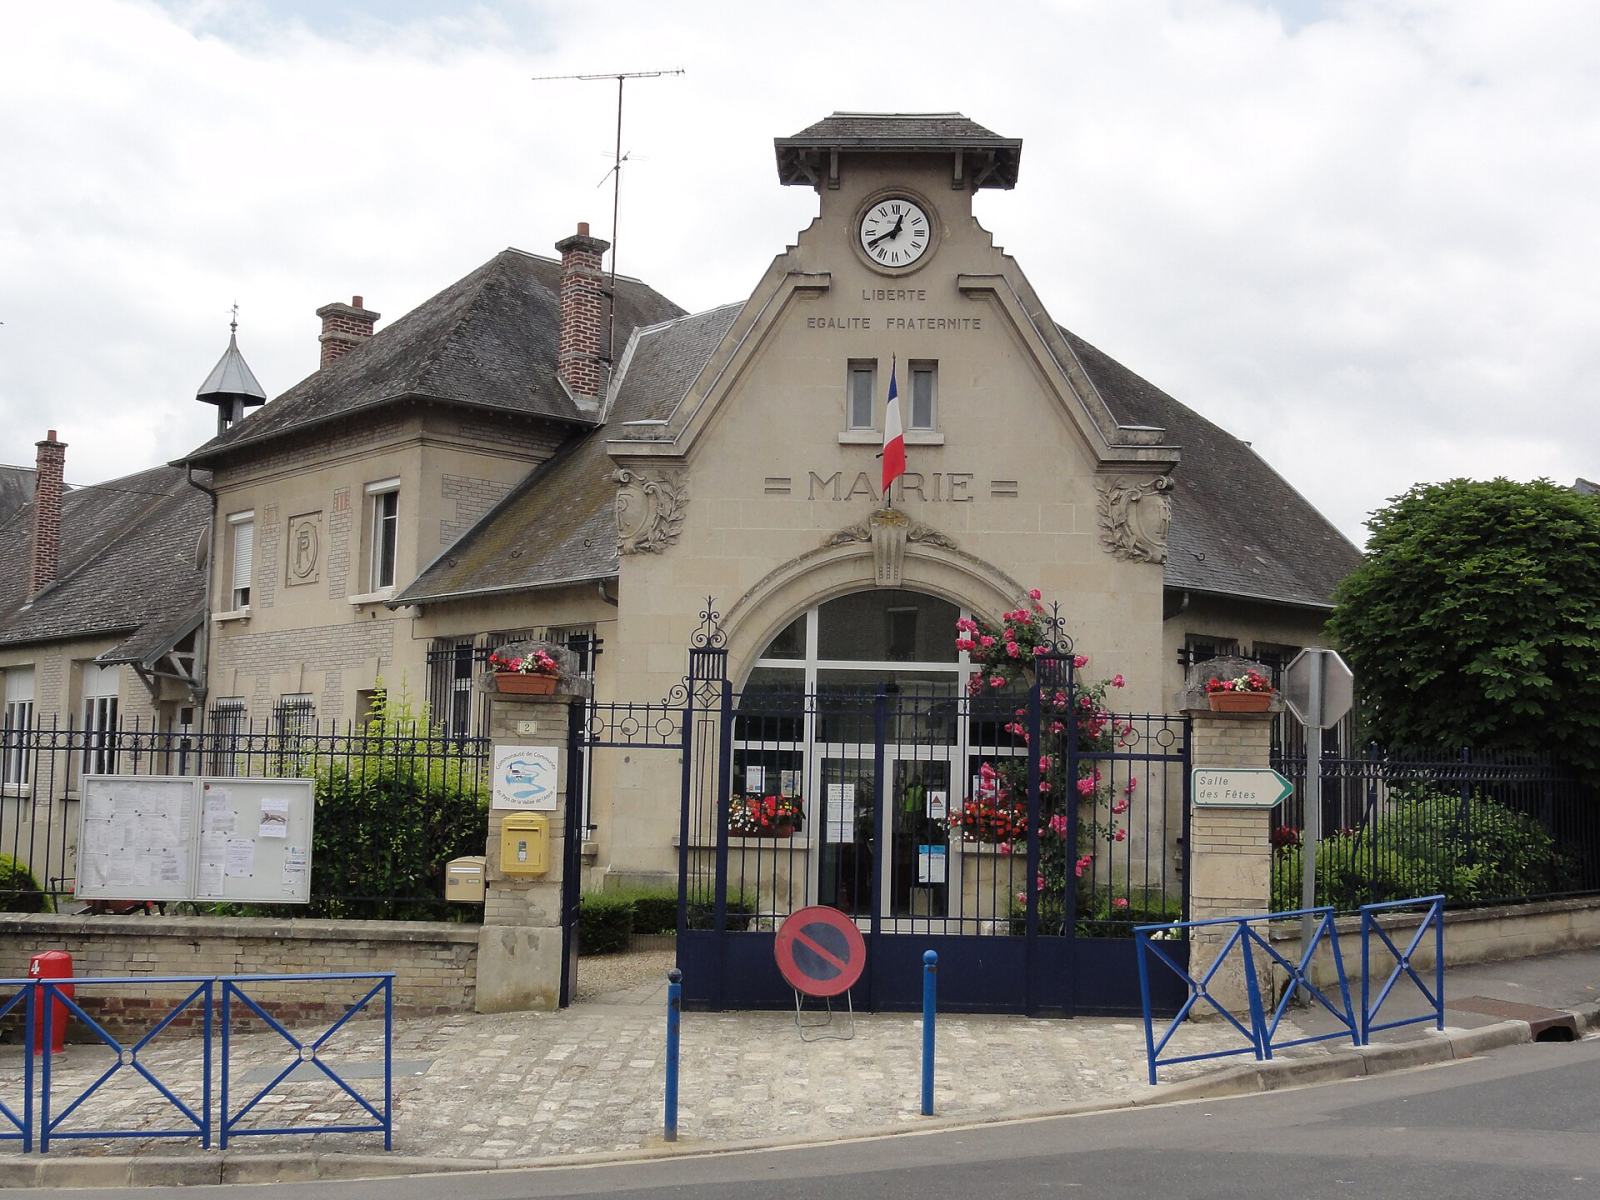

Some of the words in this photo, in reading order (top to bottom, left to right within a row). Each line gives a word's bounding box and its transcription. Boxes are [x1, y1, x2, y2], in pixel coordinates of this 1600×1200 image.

[862, 290, 927, 302] LIBERTE
[807, 317, 871, 330] EGALITE
[886, 318, 982, 331] FRATERNITE
[524, 723, 530, 732] 2
[1200, 776, 1229, 785] Salle
[1200, 789, 1219, 799] des
[1225, 789, 1256, 799] Fêtes
[31, 959, 40, 975] 4
